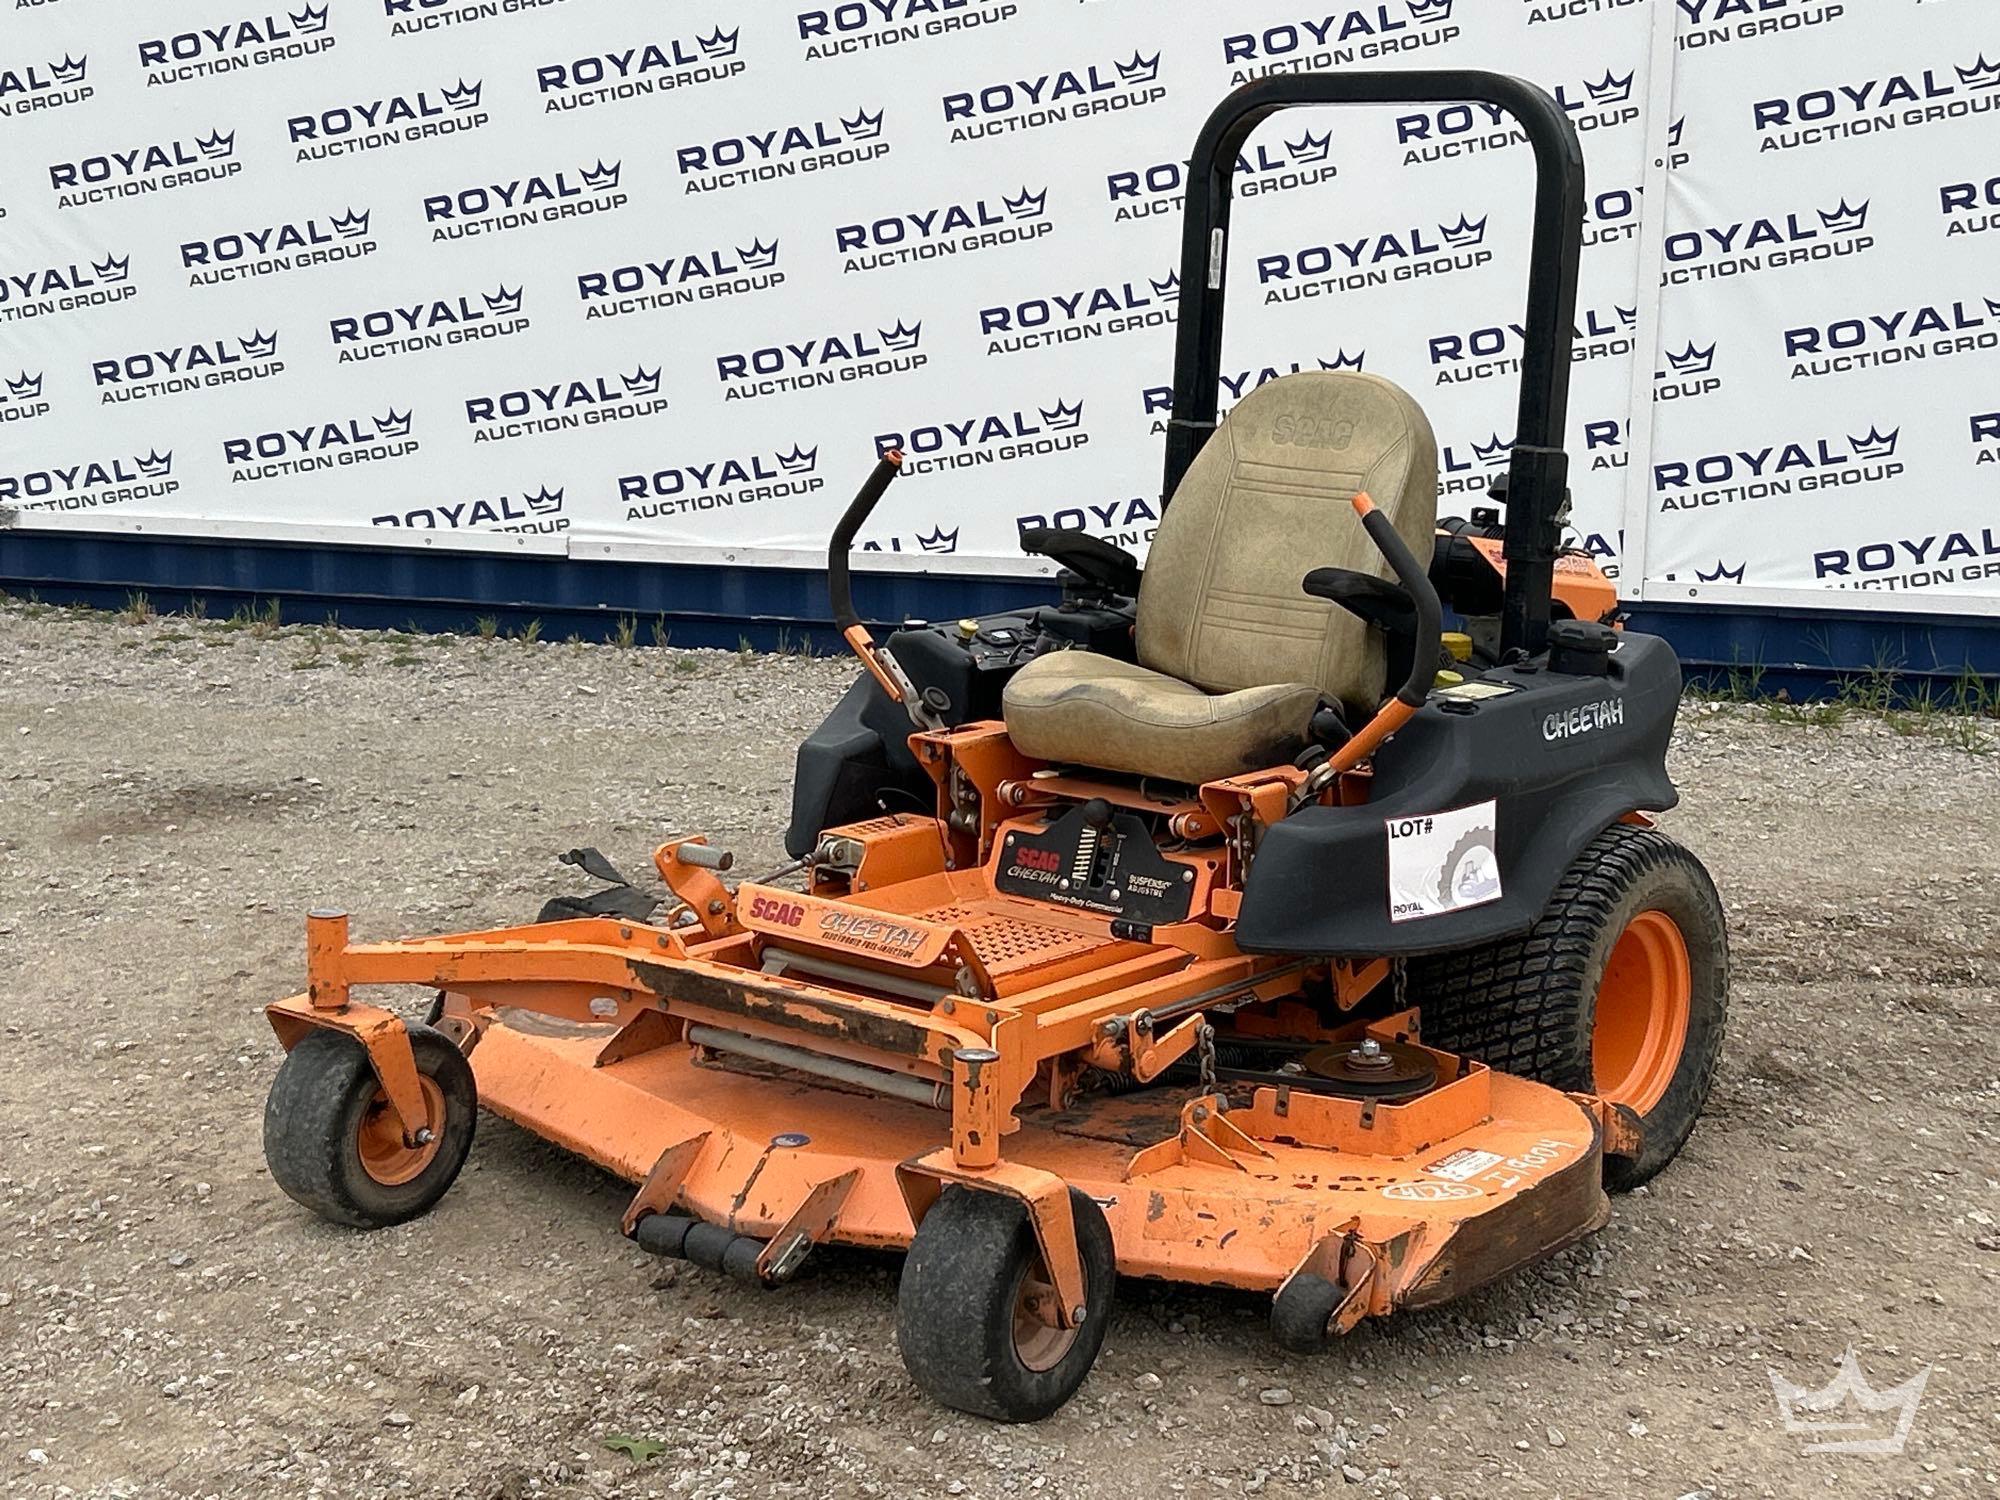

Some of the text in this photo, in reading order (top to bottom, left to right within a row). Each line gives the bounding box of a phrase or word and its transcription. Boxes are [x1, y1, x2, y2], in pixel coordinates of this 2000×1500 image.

[139, 17, 290, 67] ROYAL
[392, 2, 497, 36] AUCTION
[806, 5, 1017, 61] AUCTION GROUP
[1223, 4, 1405, 64] ROYAL
[1361, 26, 1459, 58] GROUP
[1738, 5, 1843, 38] GROUP
[147, 37, 335, 87] AUCTION GROUP
[537, 40, 698, 92] ROYAL
[16, 87, 93, 113] GROUP
[545, 61, 745, 113] AUCTION GROUP
[943, 66, 1115, 122] ROYAL
[1754, 70, 1954, 130] ROYAL
[288, 93, 443, 143] ROYAL
[296, 113, 488, 162] AUCTION GROUP
[951, 87, 1166, 143] AUCTION GROUP
[1760, 114, 1895, 152] AUCTION
[49, 142, 197, 189] ROYAL
[677, 122, 841, 174] ROYAL
[686, 143, 889, 194] AUCTION GROUP
[59, 162, 241, 209] AUCTION GROUP
[424, 173, 581, 222] ROYAL
[1241, 167, 1337, 197] GROUP
[433, 194, 627, 242] AUCTION GROUP
[836, 201, 1003, 253] ROYAL
[180, 221, 332, 268] ROYAL
[190, 242, 376, 287] AUCTION GROUP
[844, 222, 1052, 273] AUCTION GROUP
[1258, 229, 1439, 284] ROYAL
[1768, 237, 1873, 267] GROUP
[59, 286, 136, 310] GROUP
[578, 251, 738, 300] ROYAL
[587, 273, 784, 320] AUCTION GROUP
[1265, 251, 1492, 305] AUCTION GROUP
[330, 297, 484, 344] ROYAL
[980, 283, 1150, 335] ROYAL
[988, 308, 1180, 355] AUCTION GROU
[1785, 301, 1983, 357] ROYAL
[93, 341, 240, 386] ROYAL
[339, 319, 529, 363] AUCTION GROUP
[717, 333, 880, 381] ROYAL
[1791, 344, 1925, 379] AUCTION
[102, 362, 284, 405] AUCTION GROUP
[466, 378, 622, 423] ROYAL
[726, 355, 927, 401] AUCTION GROUP
[224, 420, 374, 464] ROYAL
[475, 399, 667, 443] AUCTION GROUP
[233, 441, 418, 482] AUCTION GROUP
[999, 434, 1088, 460] GROUP
[1654, 440, 1847, 491] ROYAL
[102, 481, 179, 504] GROUP
[618, 456, 777, 501] ROYAL
[627, 478, 823, 520] AUCTION GROUP
[1661, 463, 1903, 512] AUCTION GROUP
[1543, 697, 1623, 740] CHEETAH
[1390, 818, 1433, 839] LOT#
[1007, 866, 1061, 884] CHEETAH
[1016, 847, 1061, 871] SCAG
[749, 897, 805, 927] SCAG
[819, 911, 930, 951] CHEETAH
[1393, 902, 1424, 914] ROYAL
